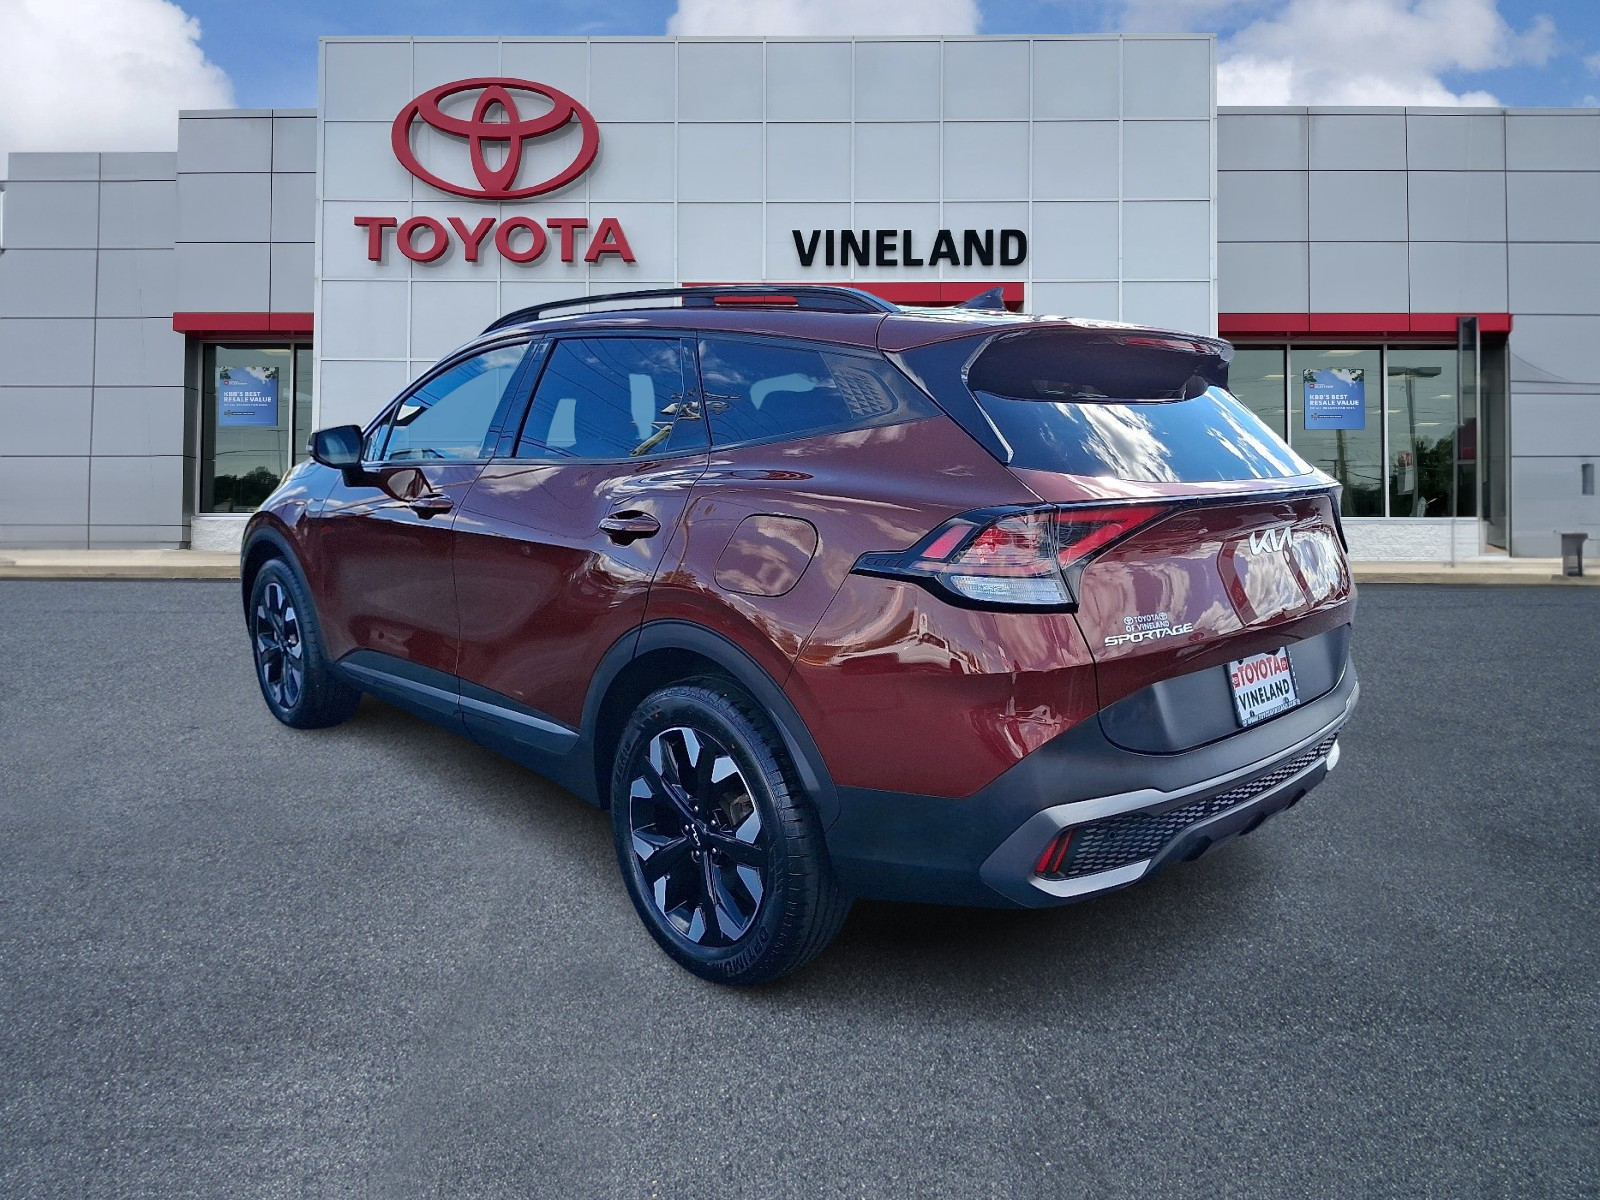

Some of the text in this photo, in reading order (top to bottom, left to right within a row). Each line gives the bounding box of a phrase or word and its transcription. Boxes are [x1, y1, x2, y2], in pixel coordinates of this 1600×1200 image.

[354, 216, 636, 263] TOYOTA
[792, 229, 1027, 266] VINELAND
[1125, 620, 1170, 633] OF VINELAND
[1133, 612, 1159, 624] TOYOTA
[1104, 622, 1194, 647] SPORTAGE
[1237, 655, 1282, 686] TOYOTA
[1238, 678, 1290, 711] VINELAND
